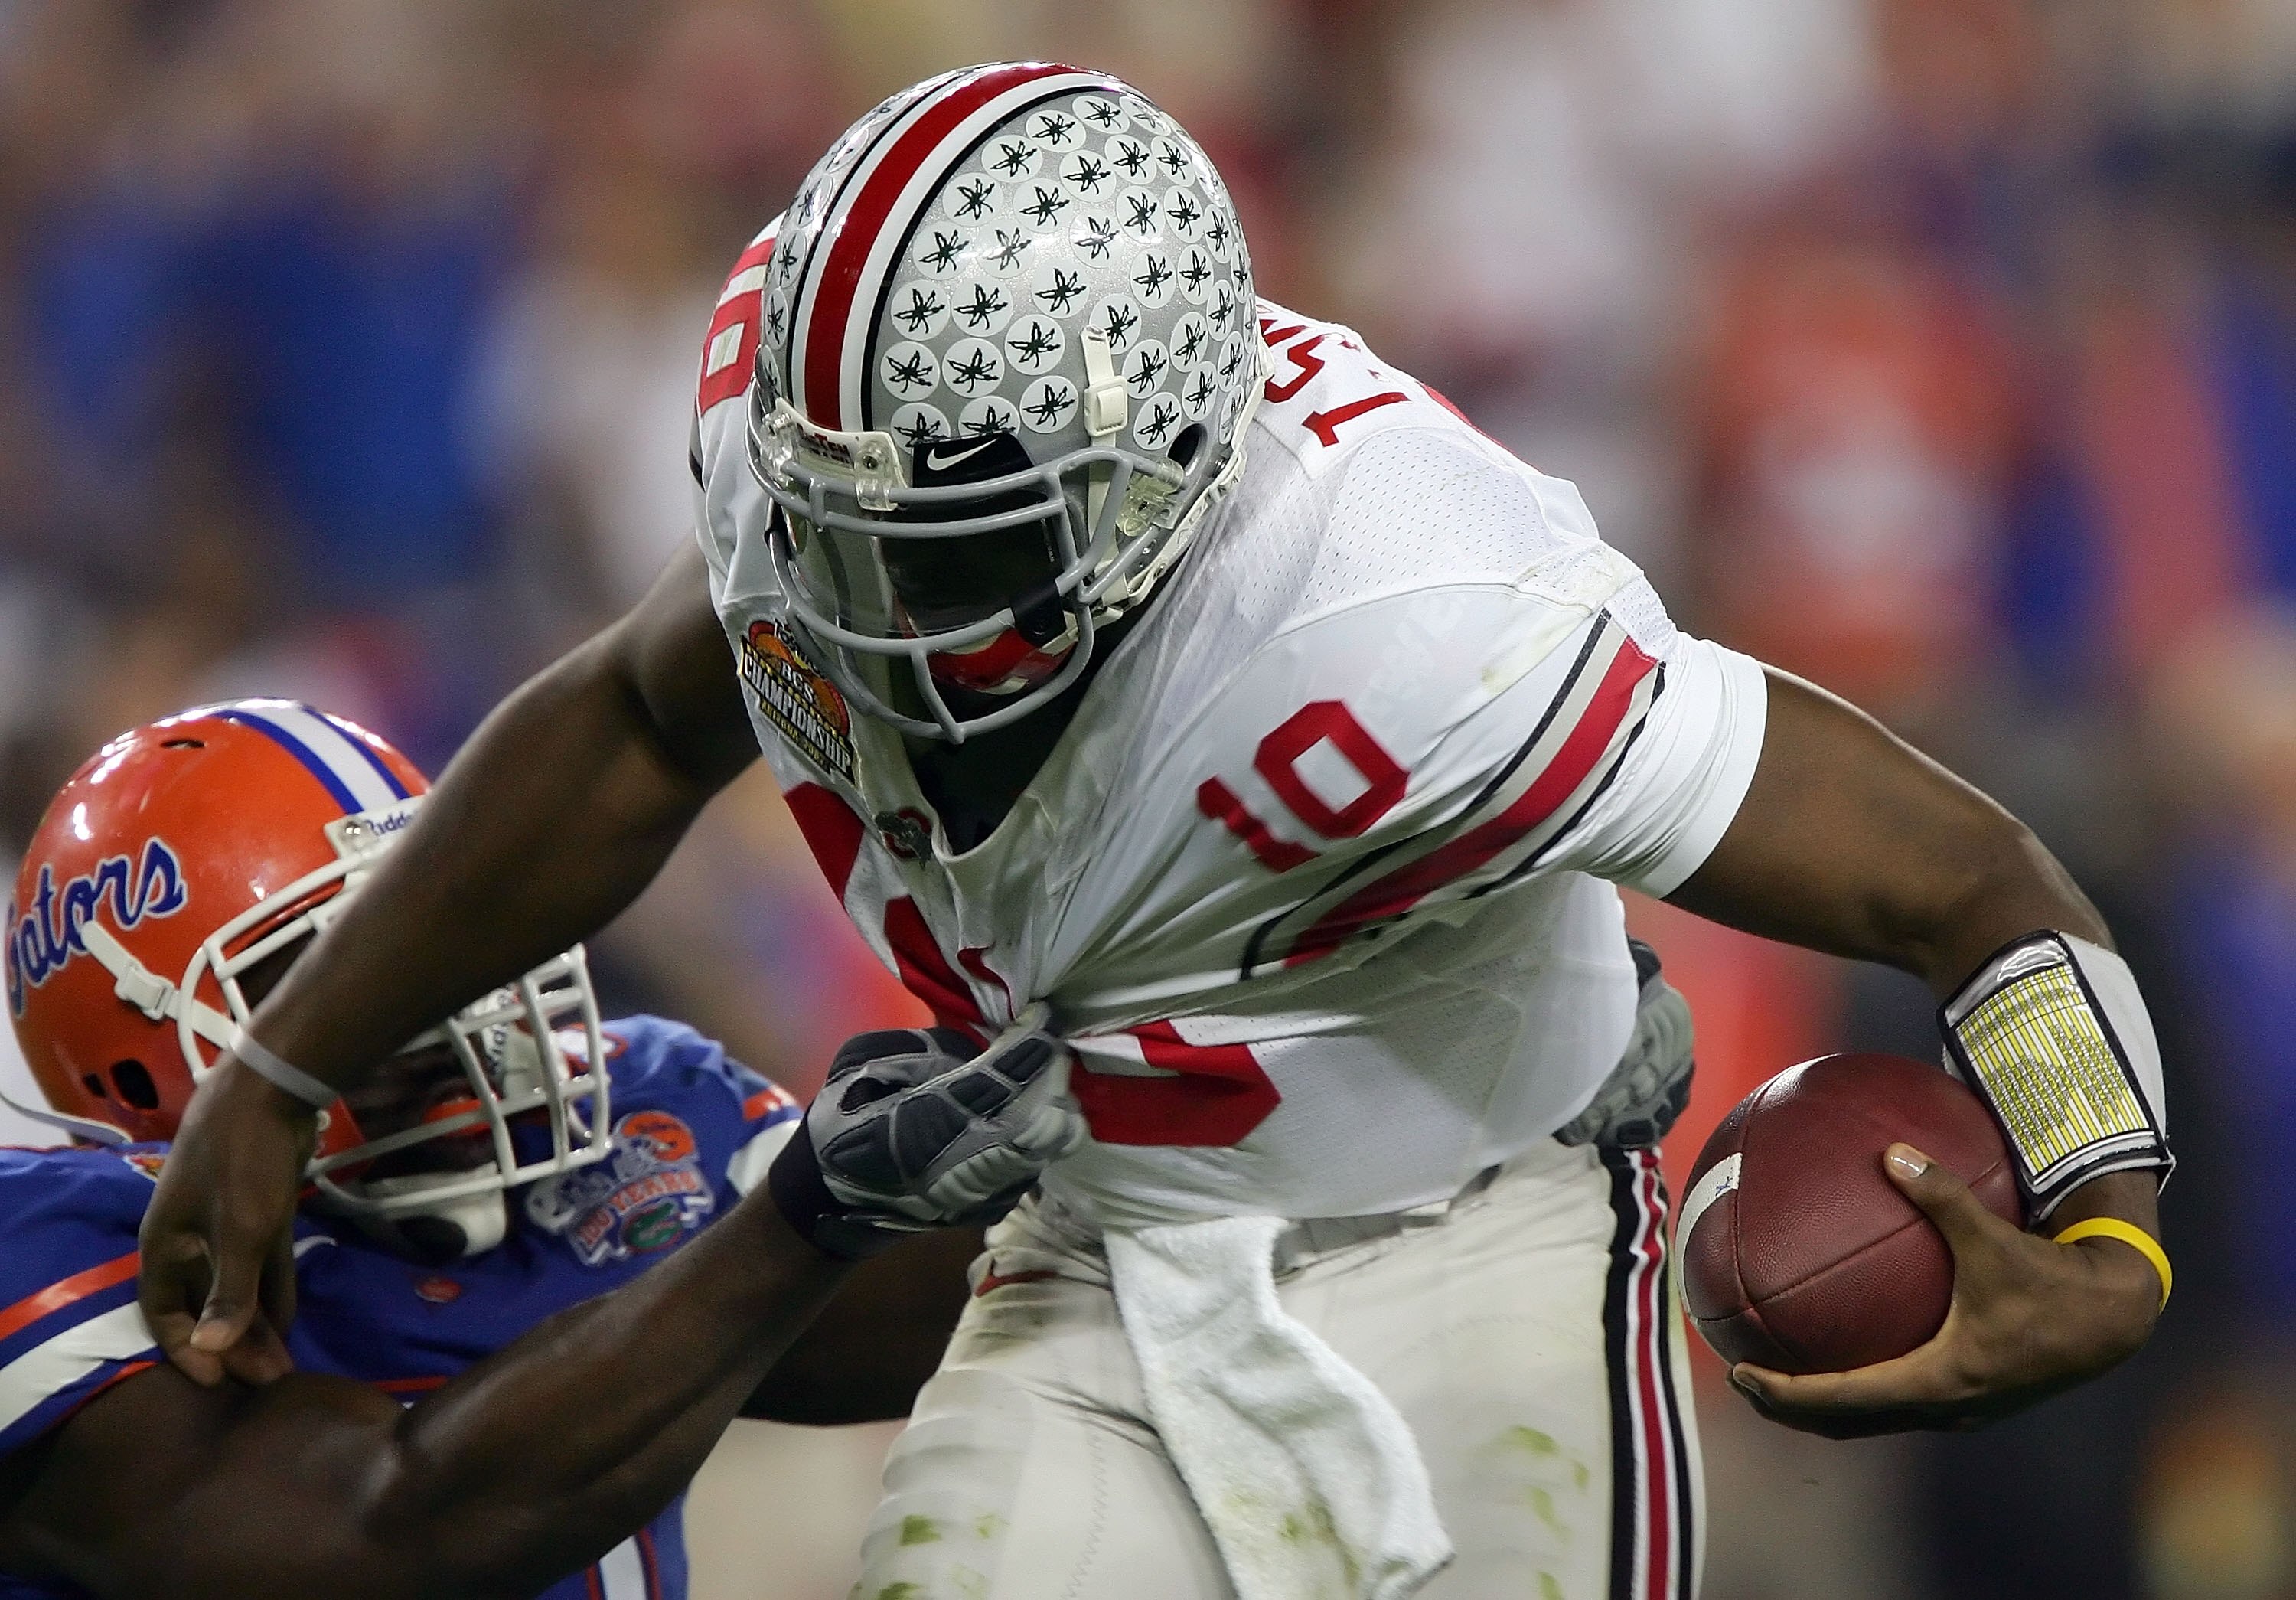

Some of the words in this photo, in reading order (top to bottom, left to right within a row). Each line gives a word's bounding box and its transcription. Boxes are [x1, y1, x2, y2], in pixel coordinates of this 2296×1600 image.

[744, 652, 851, 773] CHAMPIONSHIP
[781, 657, 815, 704] BCS
[1197, 700, 1411, 873] 10
